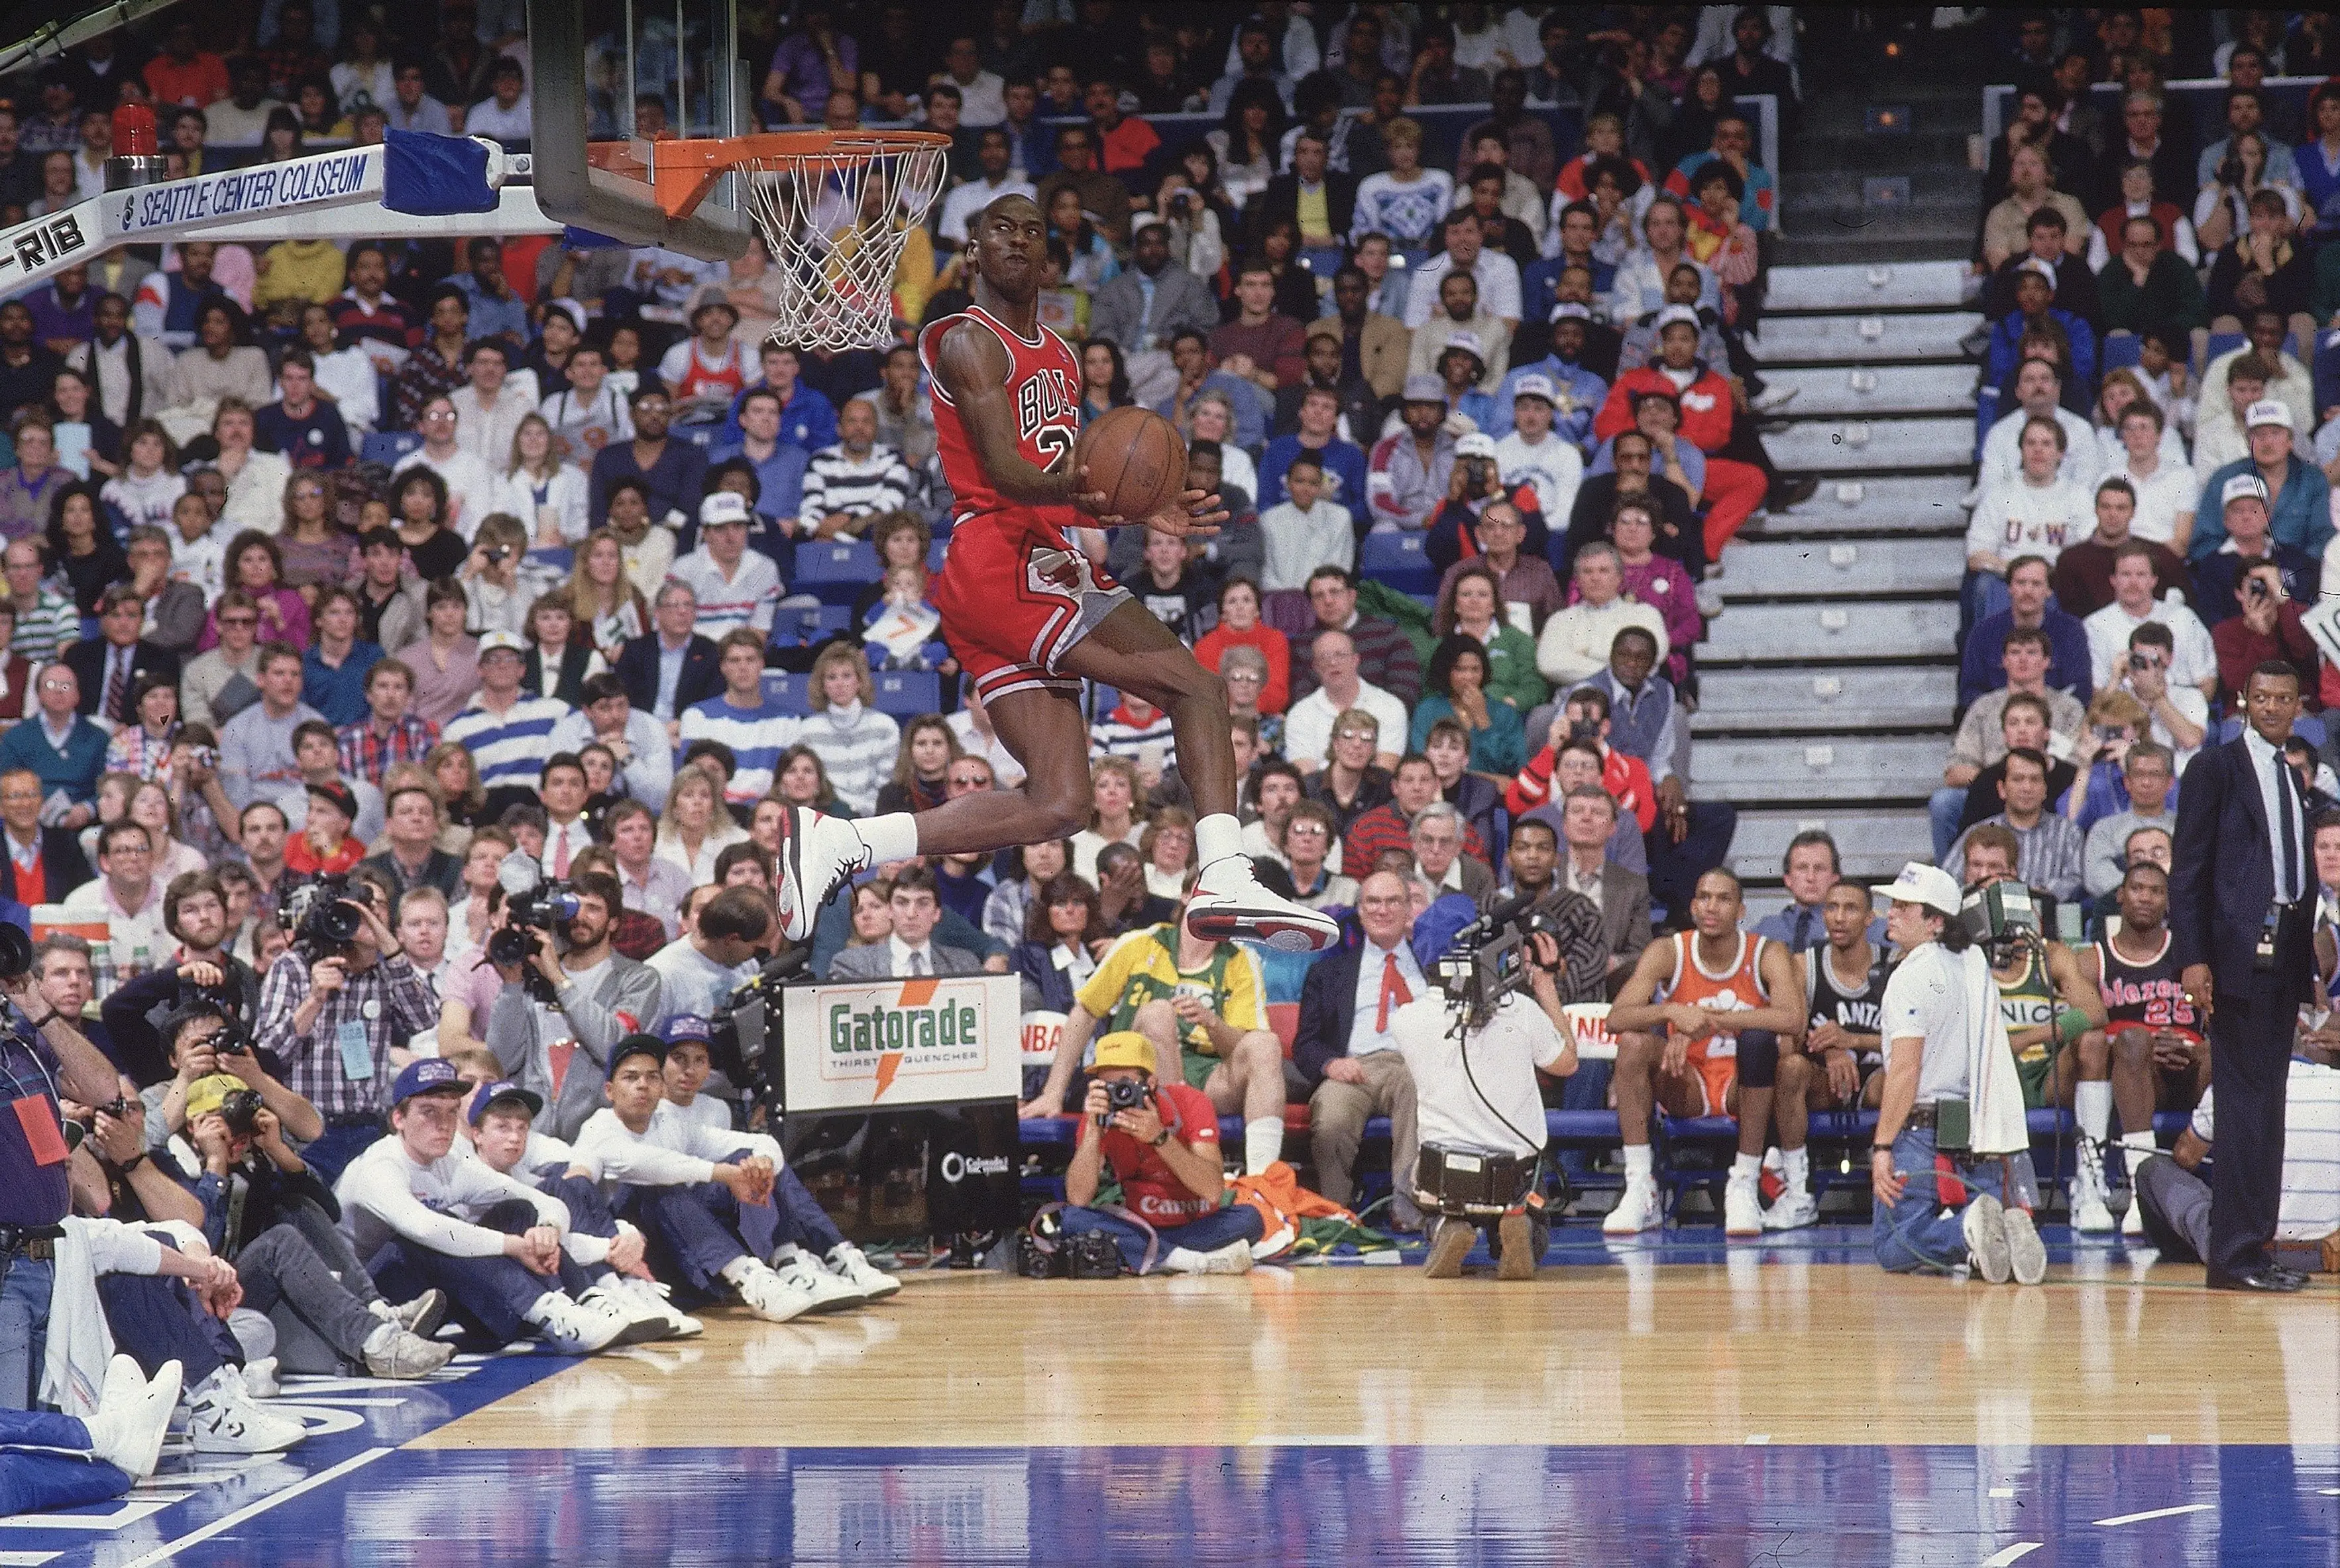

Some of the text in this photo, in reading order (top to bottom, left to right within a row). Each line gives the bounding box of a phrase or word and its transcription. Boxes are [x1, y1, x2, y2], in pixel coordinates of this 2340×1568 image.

[139, 152, 369, 227] SEATTLE CENTER COLISEUM
[830, 997, 977, 1053] Gatorade
[2144, 997, 2196, 1025] 25
[832, 1051, 978, 1068] THIRST QUENCHER
